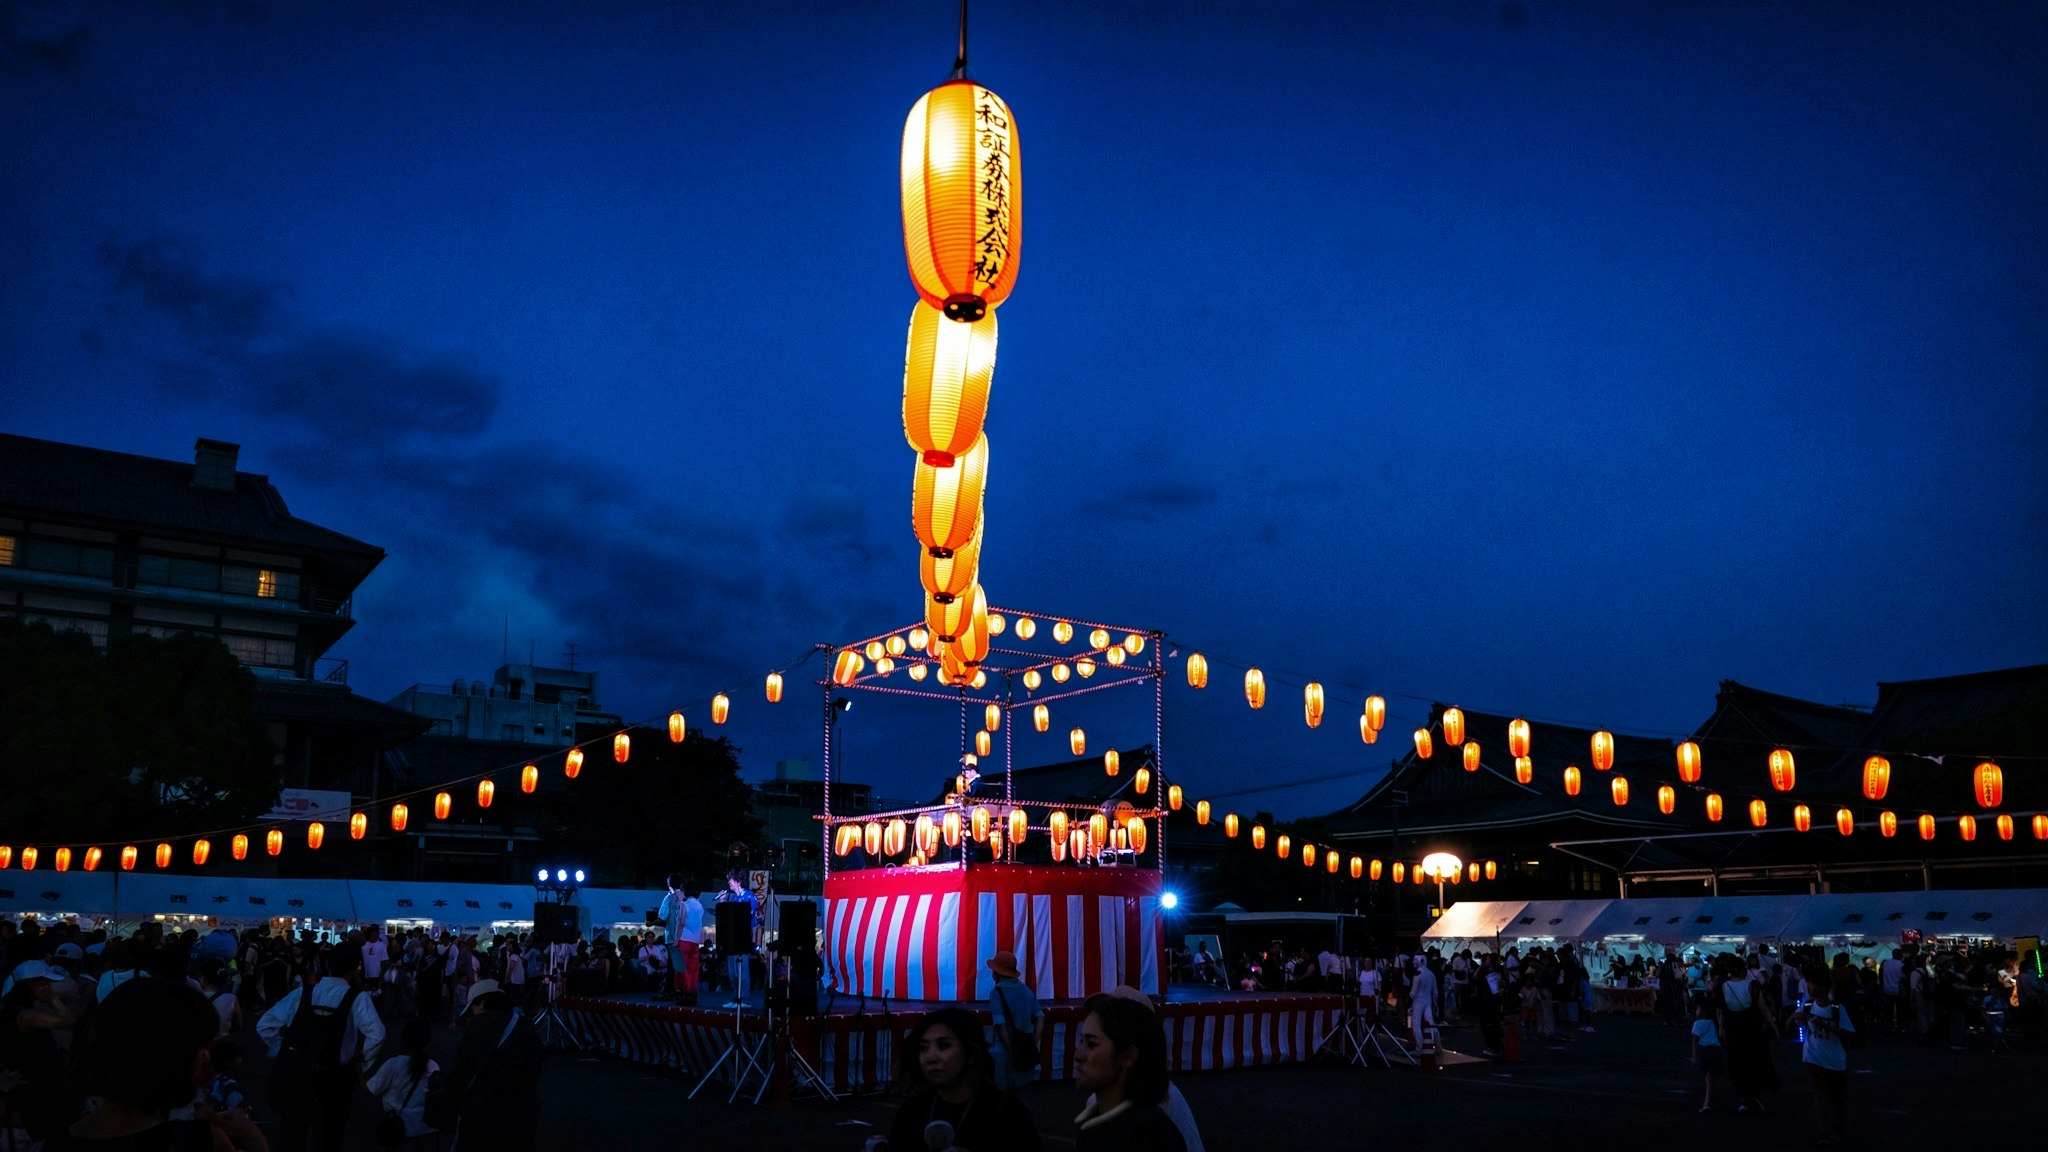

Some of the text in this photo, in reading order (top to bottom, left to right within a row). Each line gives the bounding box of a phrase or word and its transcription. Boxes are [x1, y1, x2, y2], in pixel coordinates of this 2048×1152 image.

[968, 88, 1011, 289] 大和証券株式会社
